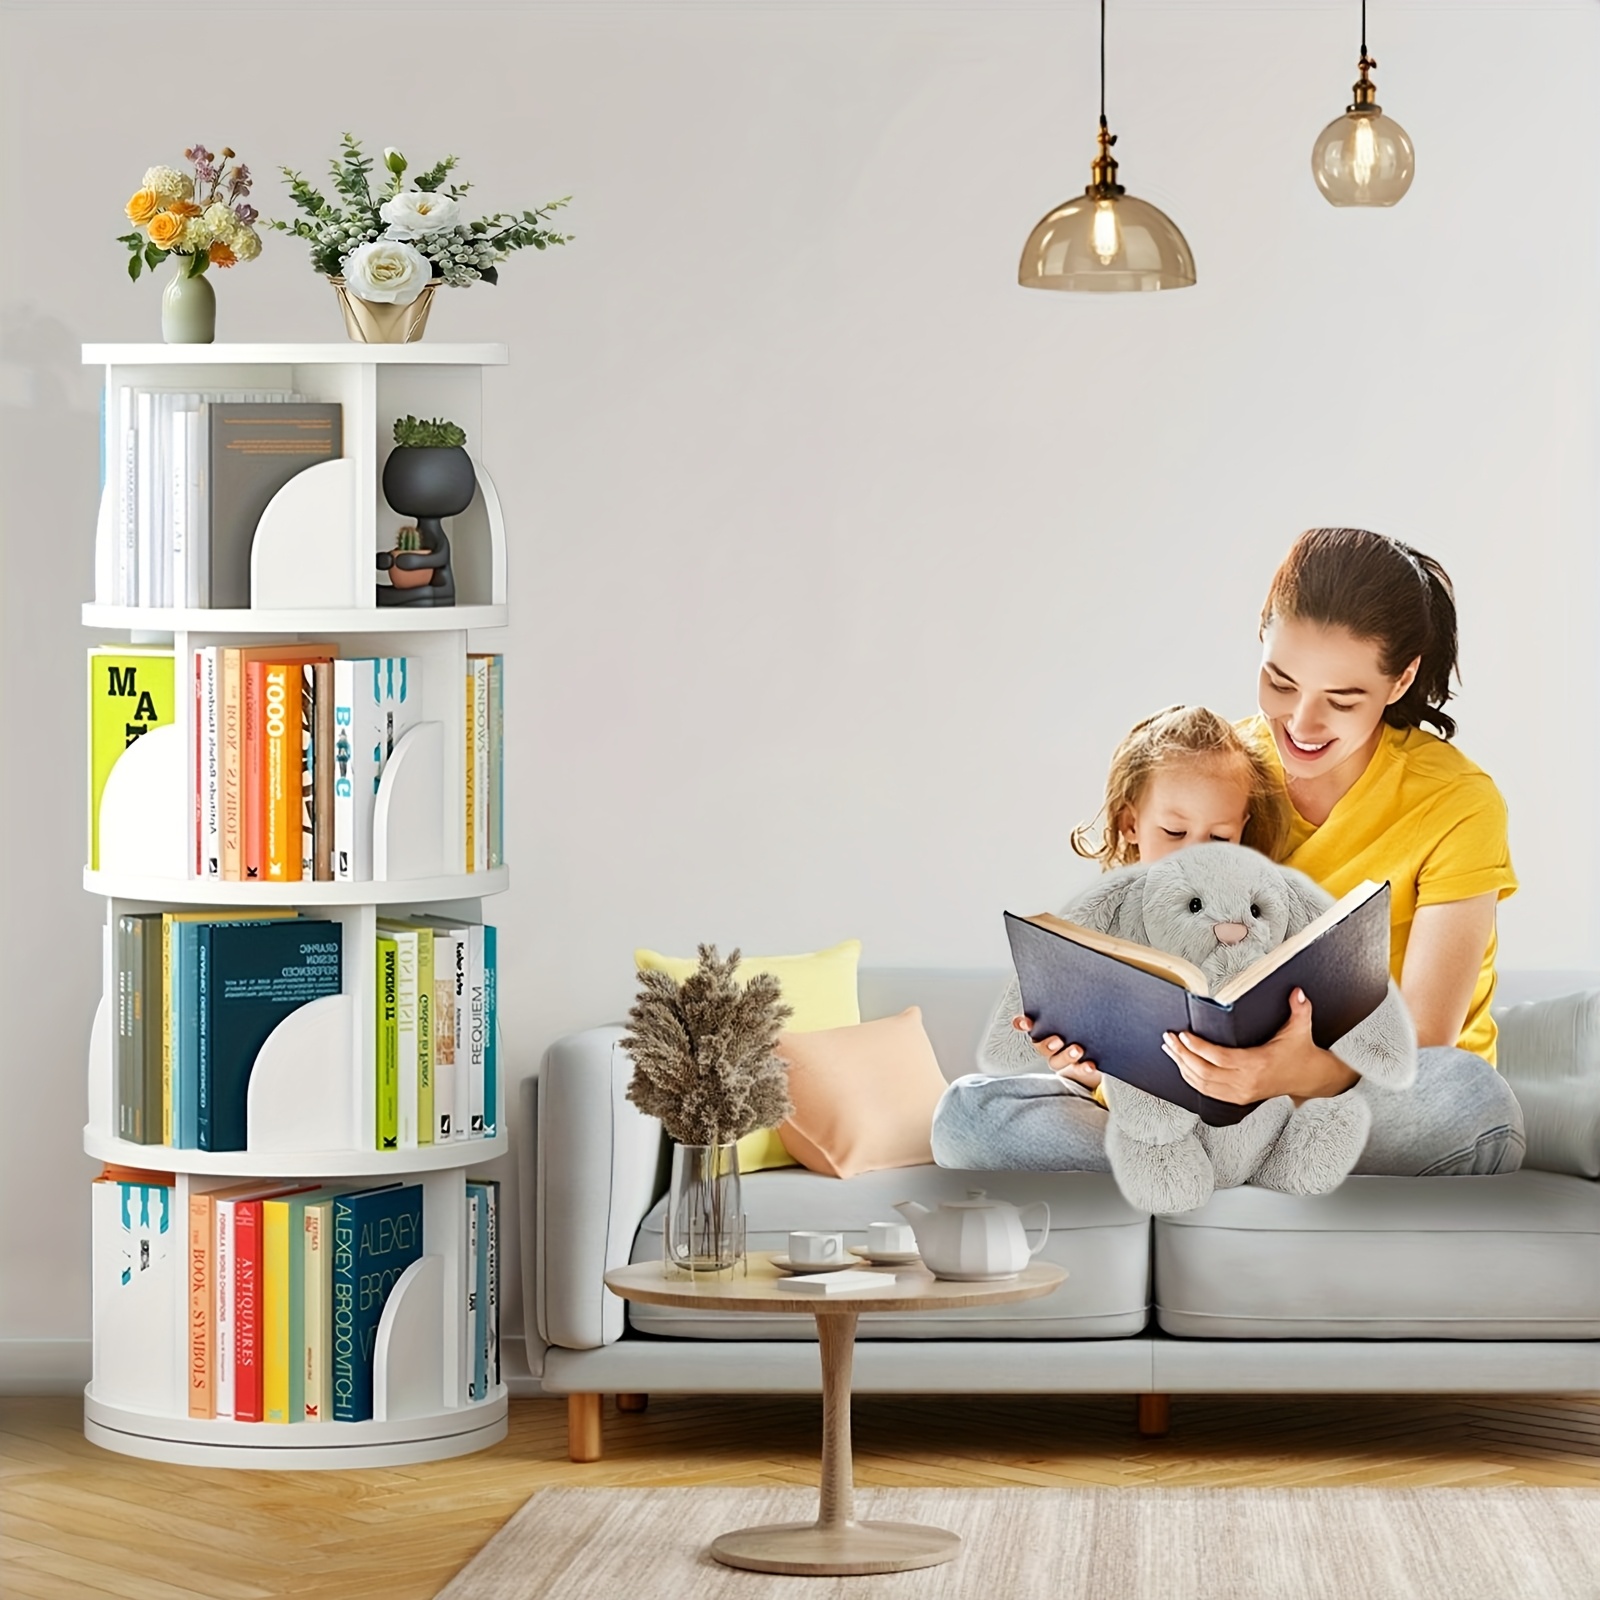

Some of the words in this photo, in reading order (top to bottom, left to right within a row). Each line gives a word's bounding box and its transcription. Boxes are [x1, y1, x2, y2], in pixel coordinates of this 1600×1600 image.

[477, 667, 486, 753] WINDOWS
[472, 986, 483, 1065] REQUIEM
[193, 1248, 206, 1294] BOOK
[335, 1202, 353, 1279] ALEXEY
[359, 1211, 420, 1259] ALEXEY
[193, 1309, 206, 1389] SYMBOLS
[239, 1258, 254, 1366] ANTIQUAIRES
[335, 1284, 353, 1408] BRODOVITCH
